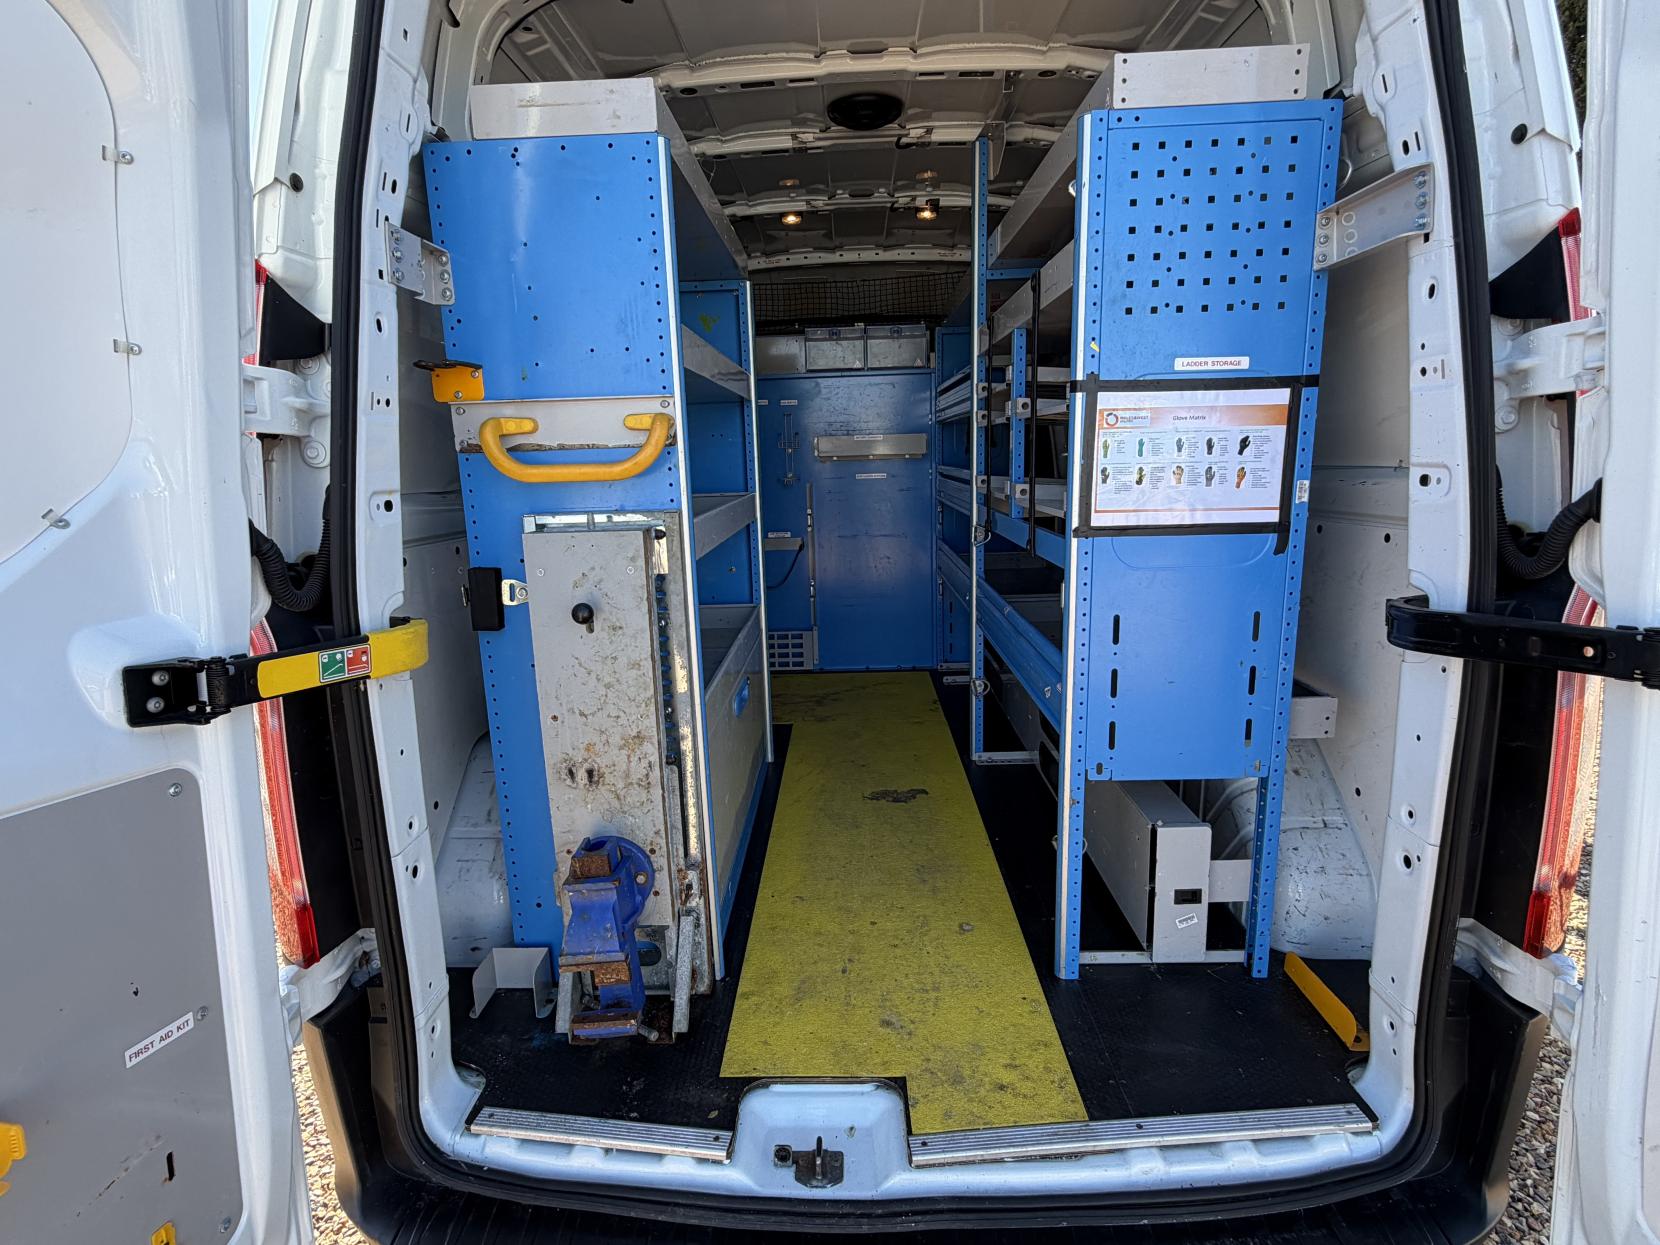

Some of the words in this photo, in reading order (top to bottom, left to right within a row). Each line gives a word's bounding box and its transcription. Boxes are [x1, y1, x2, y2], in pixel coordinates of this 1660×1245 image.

[129, 1040, 155, 1062] FIRST
[159, 1030, 174, 1044] AID
[176, 1018, 191, 1032] KIT
